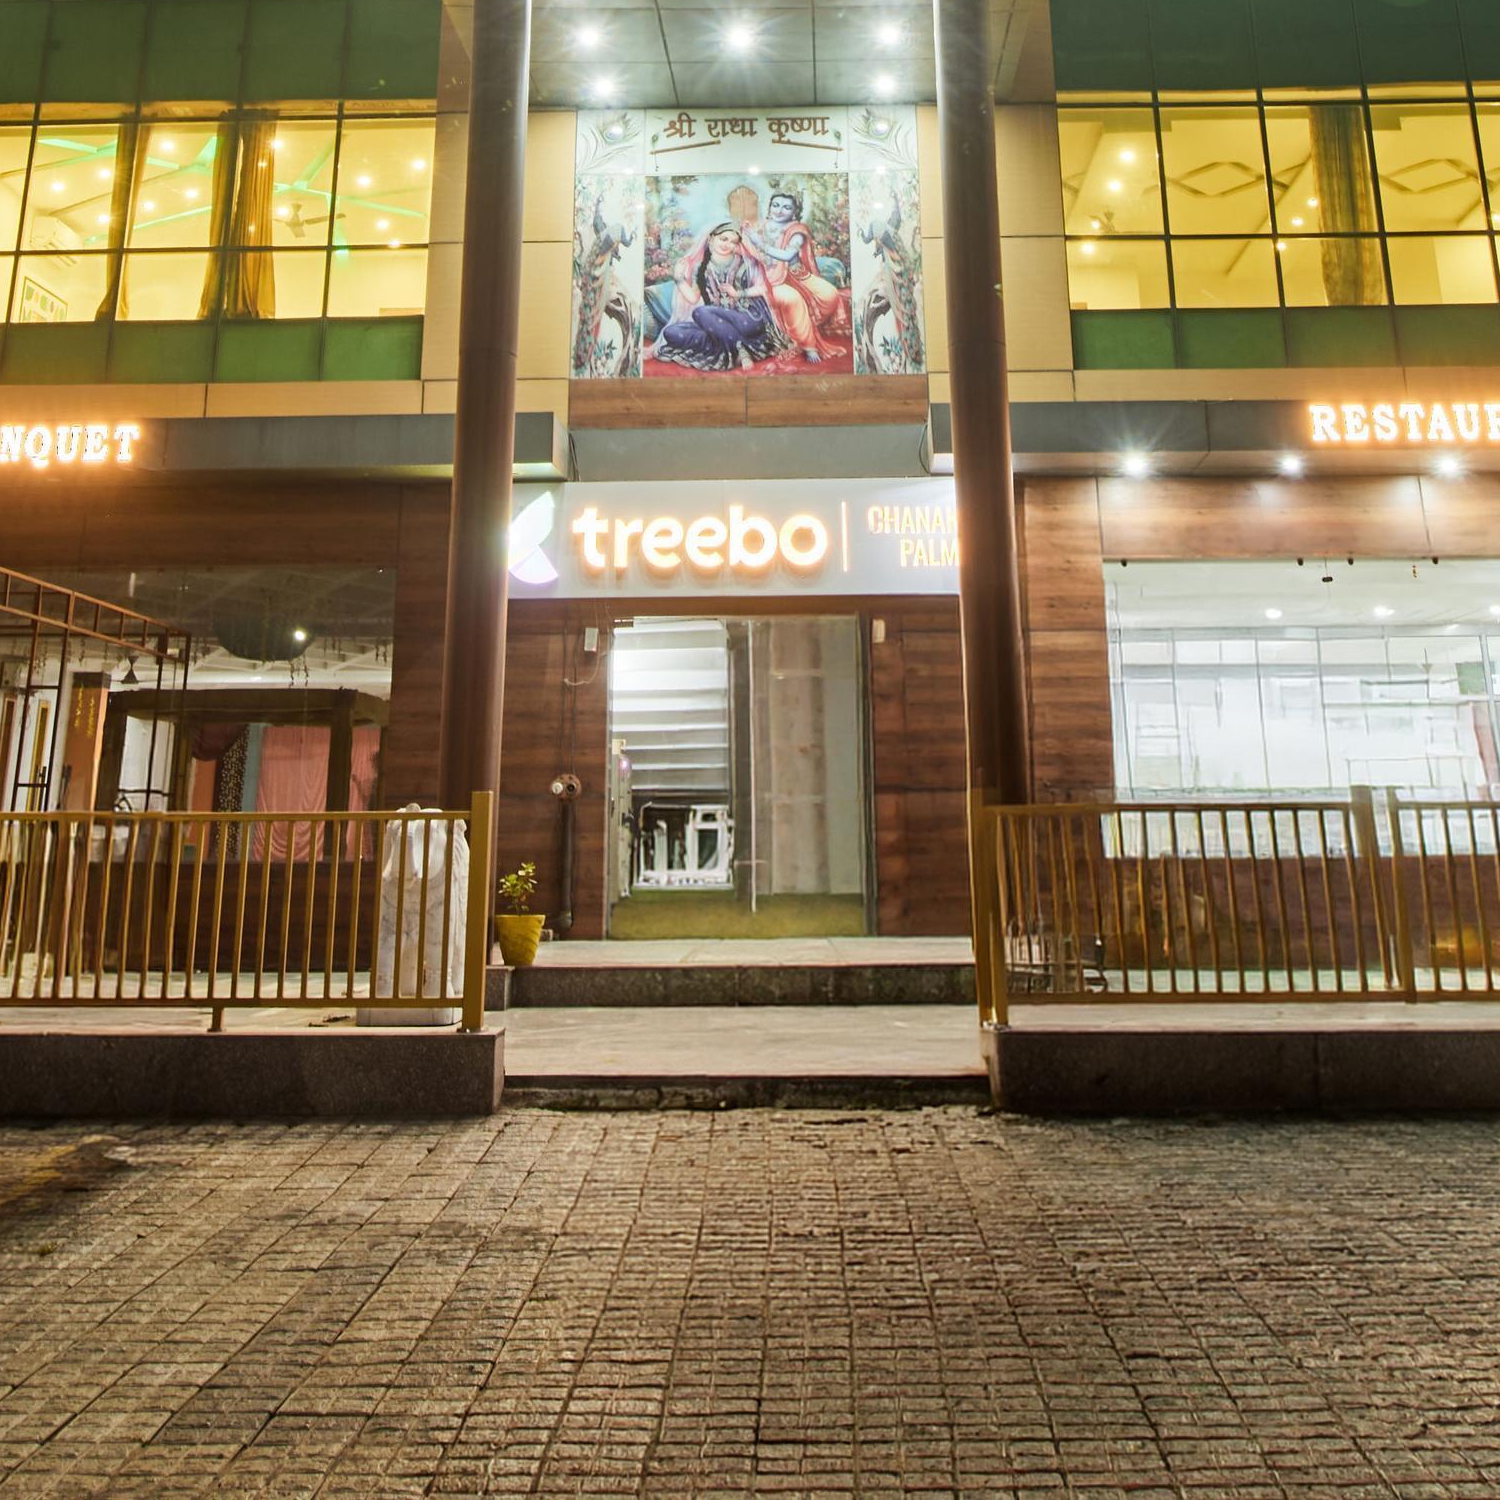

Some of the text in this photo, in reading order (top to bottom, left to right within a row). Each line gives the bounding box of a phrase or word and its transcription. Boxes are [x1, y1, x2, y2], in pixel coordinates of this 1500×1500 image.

[663, 111, 830, 141] श्री राधा कृष्णा
[867, 505, 958, 534] CHANAK
[571, 504, 829, 569] treebo
[900, 538, 960, 567] PALM
